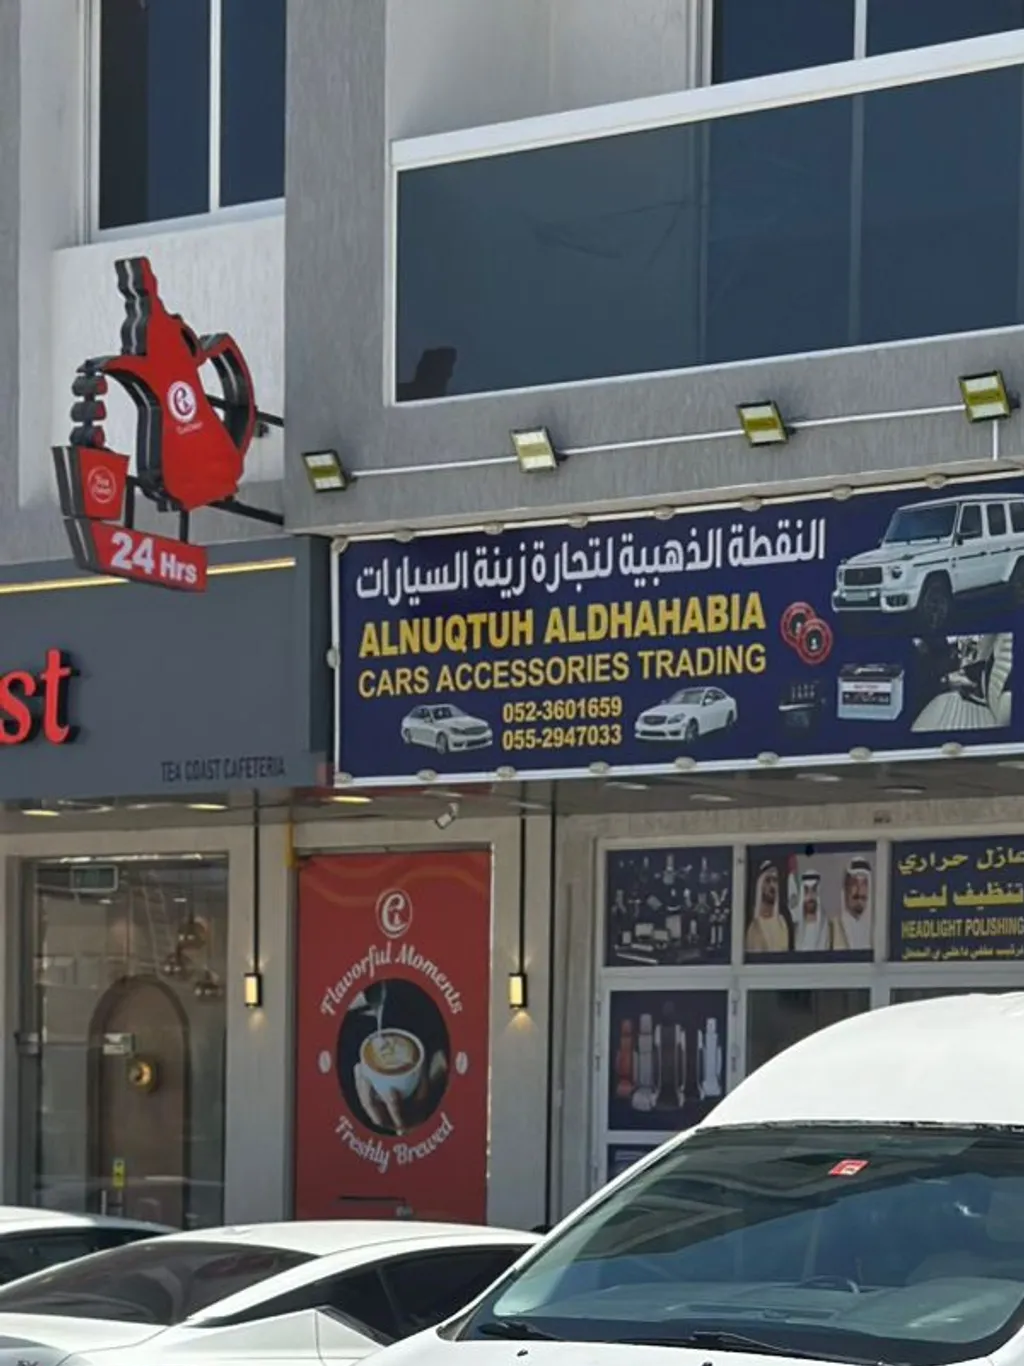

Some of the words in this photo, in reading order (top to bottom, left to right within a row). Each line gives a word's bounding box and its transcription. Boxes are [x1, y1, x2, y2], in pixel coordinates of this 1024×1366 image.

[110, 532, 155, 574] 24
[160, 552, 198, 584] Hrs
[474, 542, 526, 598] زينة
[531, 537, 613, 594] لتجارة
[619, 527, 722, 587] الذهبية
[728, 519, 826, 567] النقطة
[356, 550, 468, 606] السيارات
[359, 609, 534, 658] ALNUQTUH
[544, 592, 767, 645] ALDHAHABIA
[0, 648, 72, 745] st
[358, 666, 430, 698] CARS
[436, 652, 630, 692] ACCESSORIES
[638, 643, 767, 679] TRADING
[503, 696, 622, 723] 052-3601659
[502, 725, 622, 750] 055-2947033
[898, 852, 969, 875] حراري
[903, 884, 947, 912] ليت
[953, 882, 1024, 910] تنظيف
[901, 919, 963, 939] HEADLIGHT
[965, 916, 1024, 936] POLISHING
[320, 941, 392, 1016] Flavorful
[395, 942, 463, 1015] Moments
[335, 1115, 390, 1173] Freshly
[393, 1112, 453, 1165] Brewed
